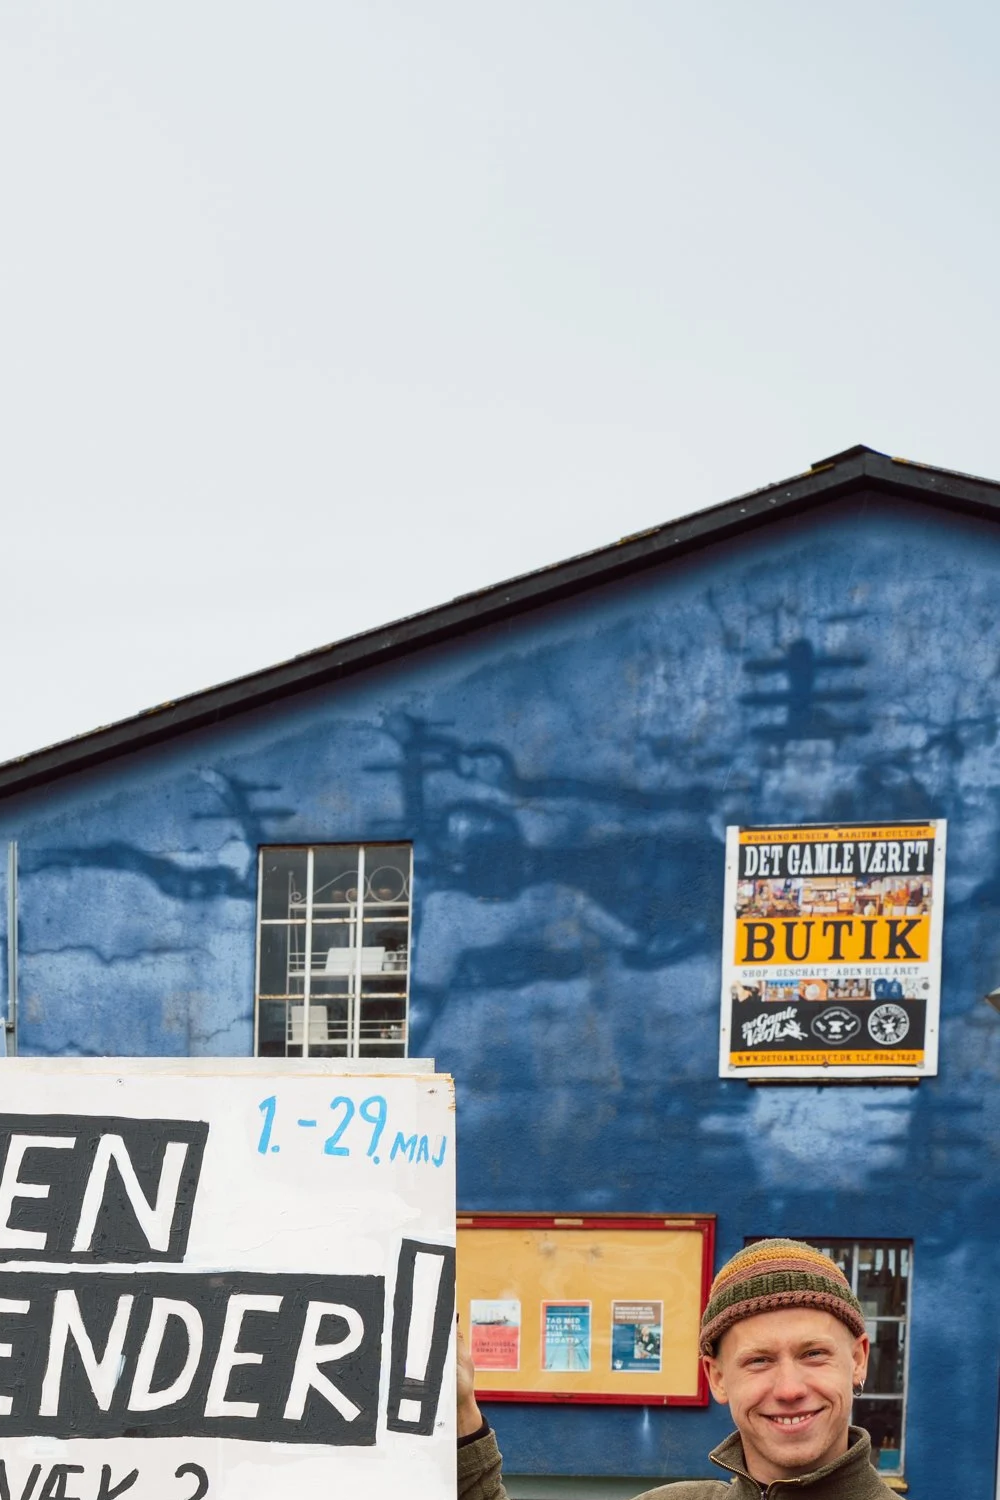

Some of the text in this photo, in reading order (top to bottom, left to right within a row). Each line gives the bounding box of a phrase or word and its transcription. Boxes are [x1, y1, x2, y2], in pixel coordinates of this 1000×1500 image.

[744, 841, 928, 877] DET GAMLE VÆRFT
[742, 919, 922, 962] BUTIK
[742, 969, 769, 978] SHOP
[756, 1006, 798, 1027] Gamle
[390, 1132, 446, 1167] MAJ
